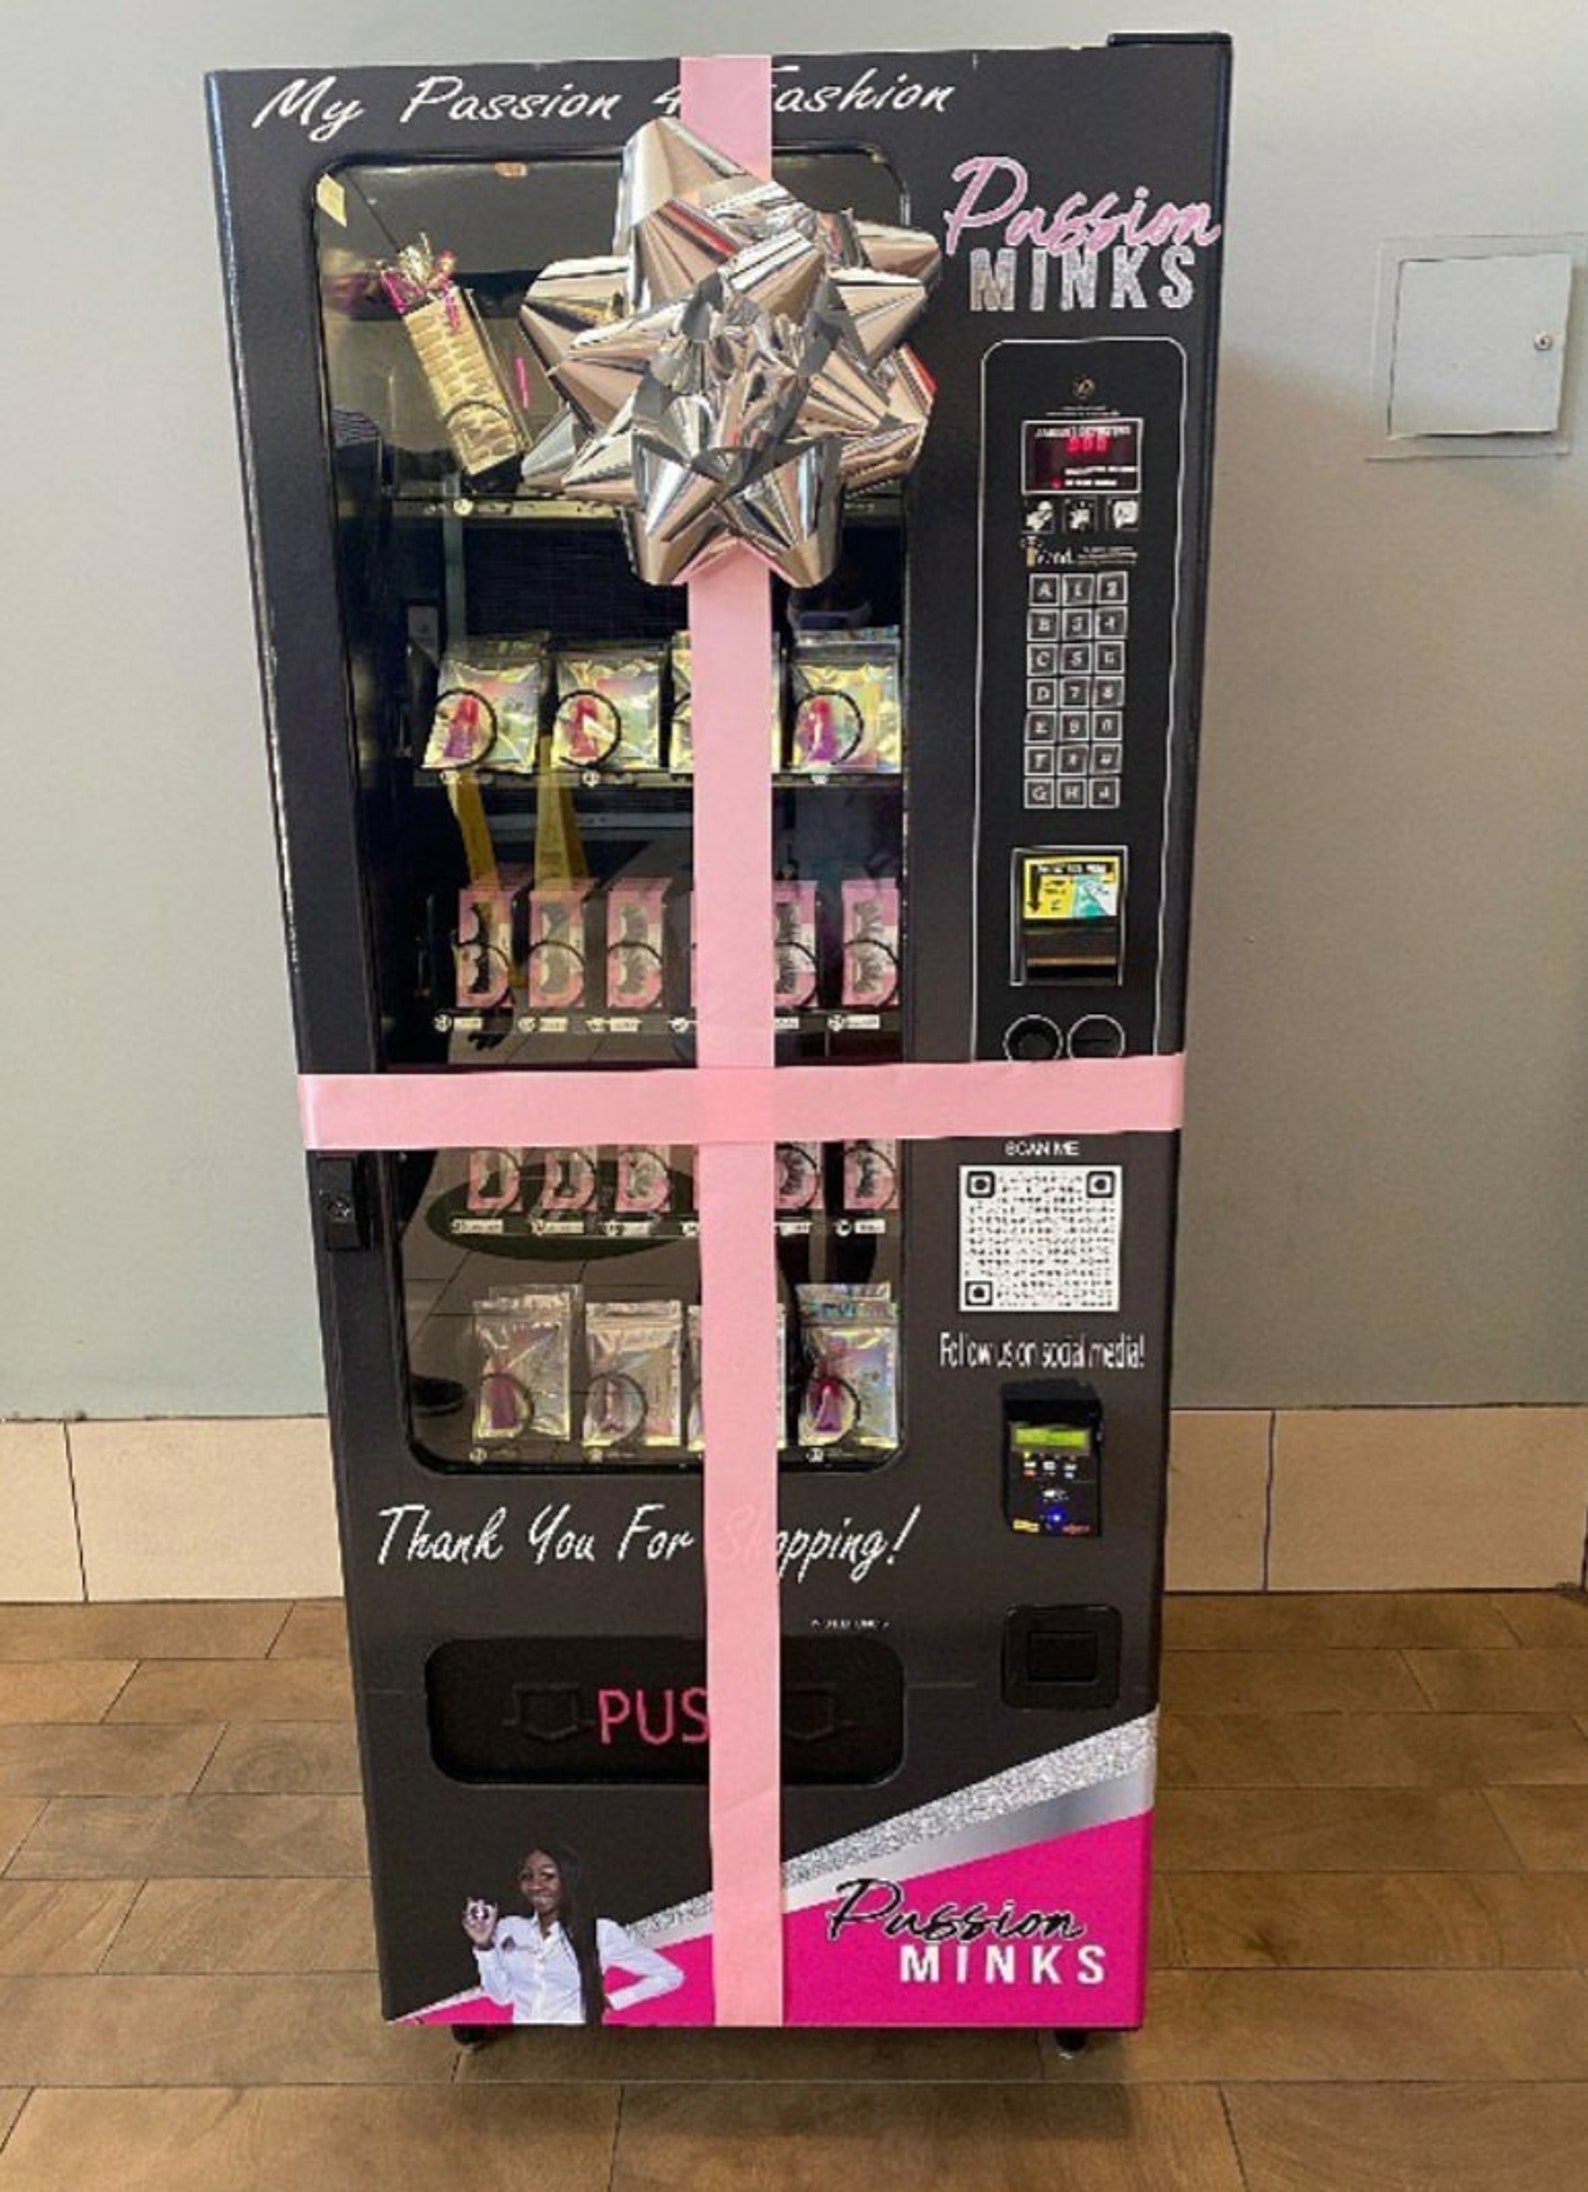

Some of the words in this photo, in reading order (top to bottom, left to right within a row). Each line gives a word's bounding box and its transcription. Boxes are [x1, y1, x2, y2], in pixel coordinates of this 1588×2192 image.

[251, 75, 366, 142] My
[399, 74, 622, 123] Passion
[770, 65, 956, 113] ashion
[944, 156, 1222, 257] Passion
[969, 245, 1196, 312] MINKS
[1004, 1140, 1050, 1156] SCAN
[1052, 1140, 1080, 1156] ME
[378, 1503, 507, 1565] Thank
[527, 1503, 596, 1565] You
[617, 1502, 696, 1562] For
[598, 1686, 710, 1746] PUS
[826, 1877, 1085, 1943] Passion
[900, 1944, 1107, 1985] MINKS
